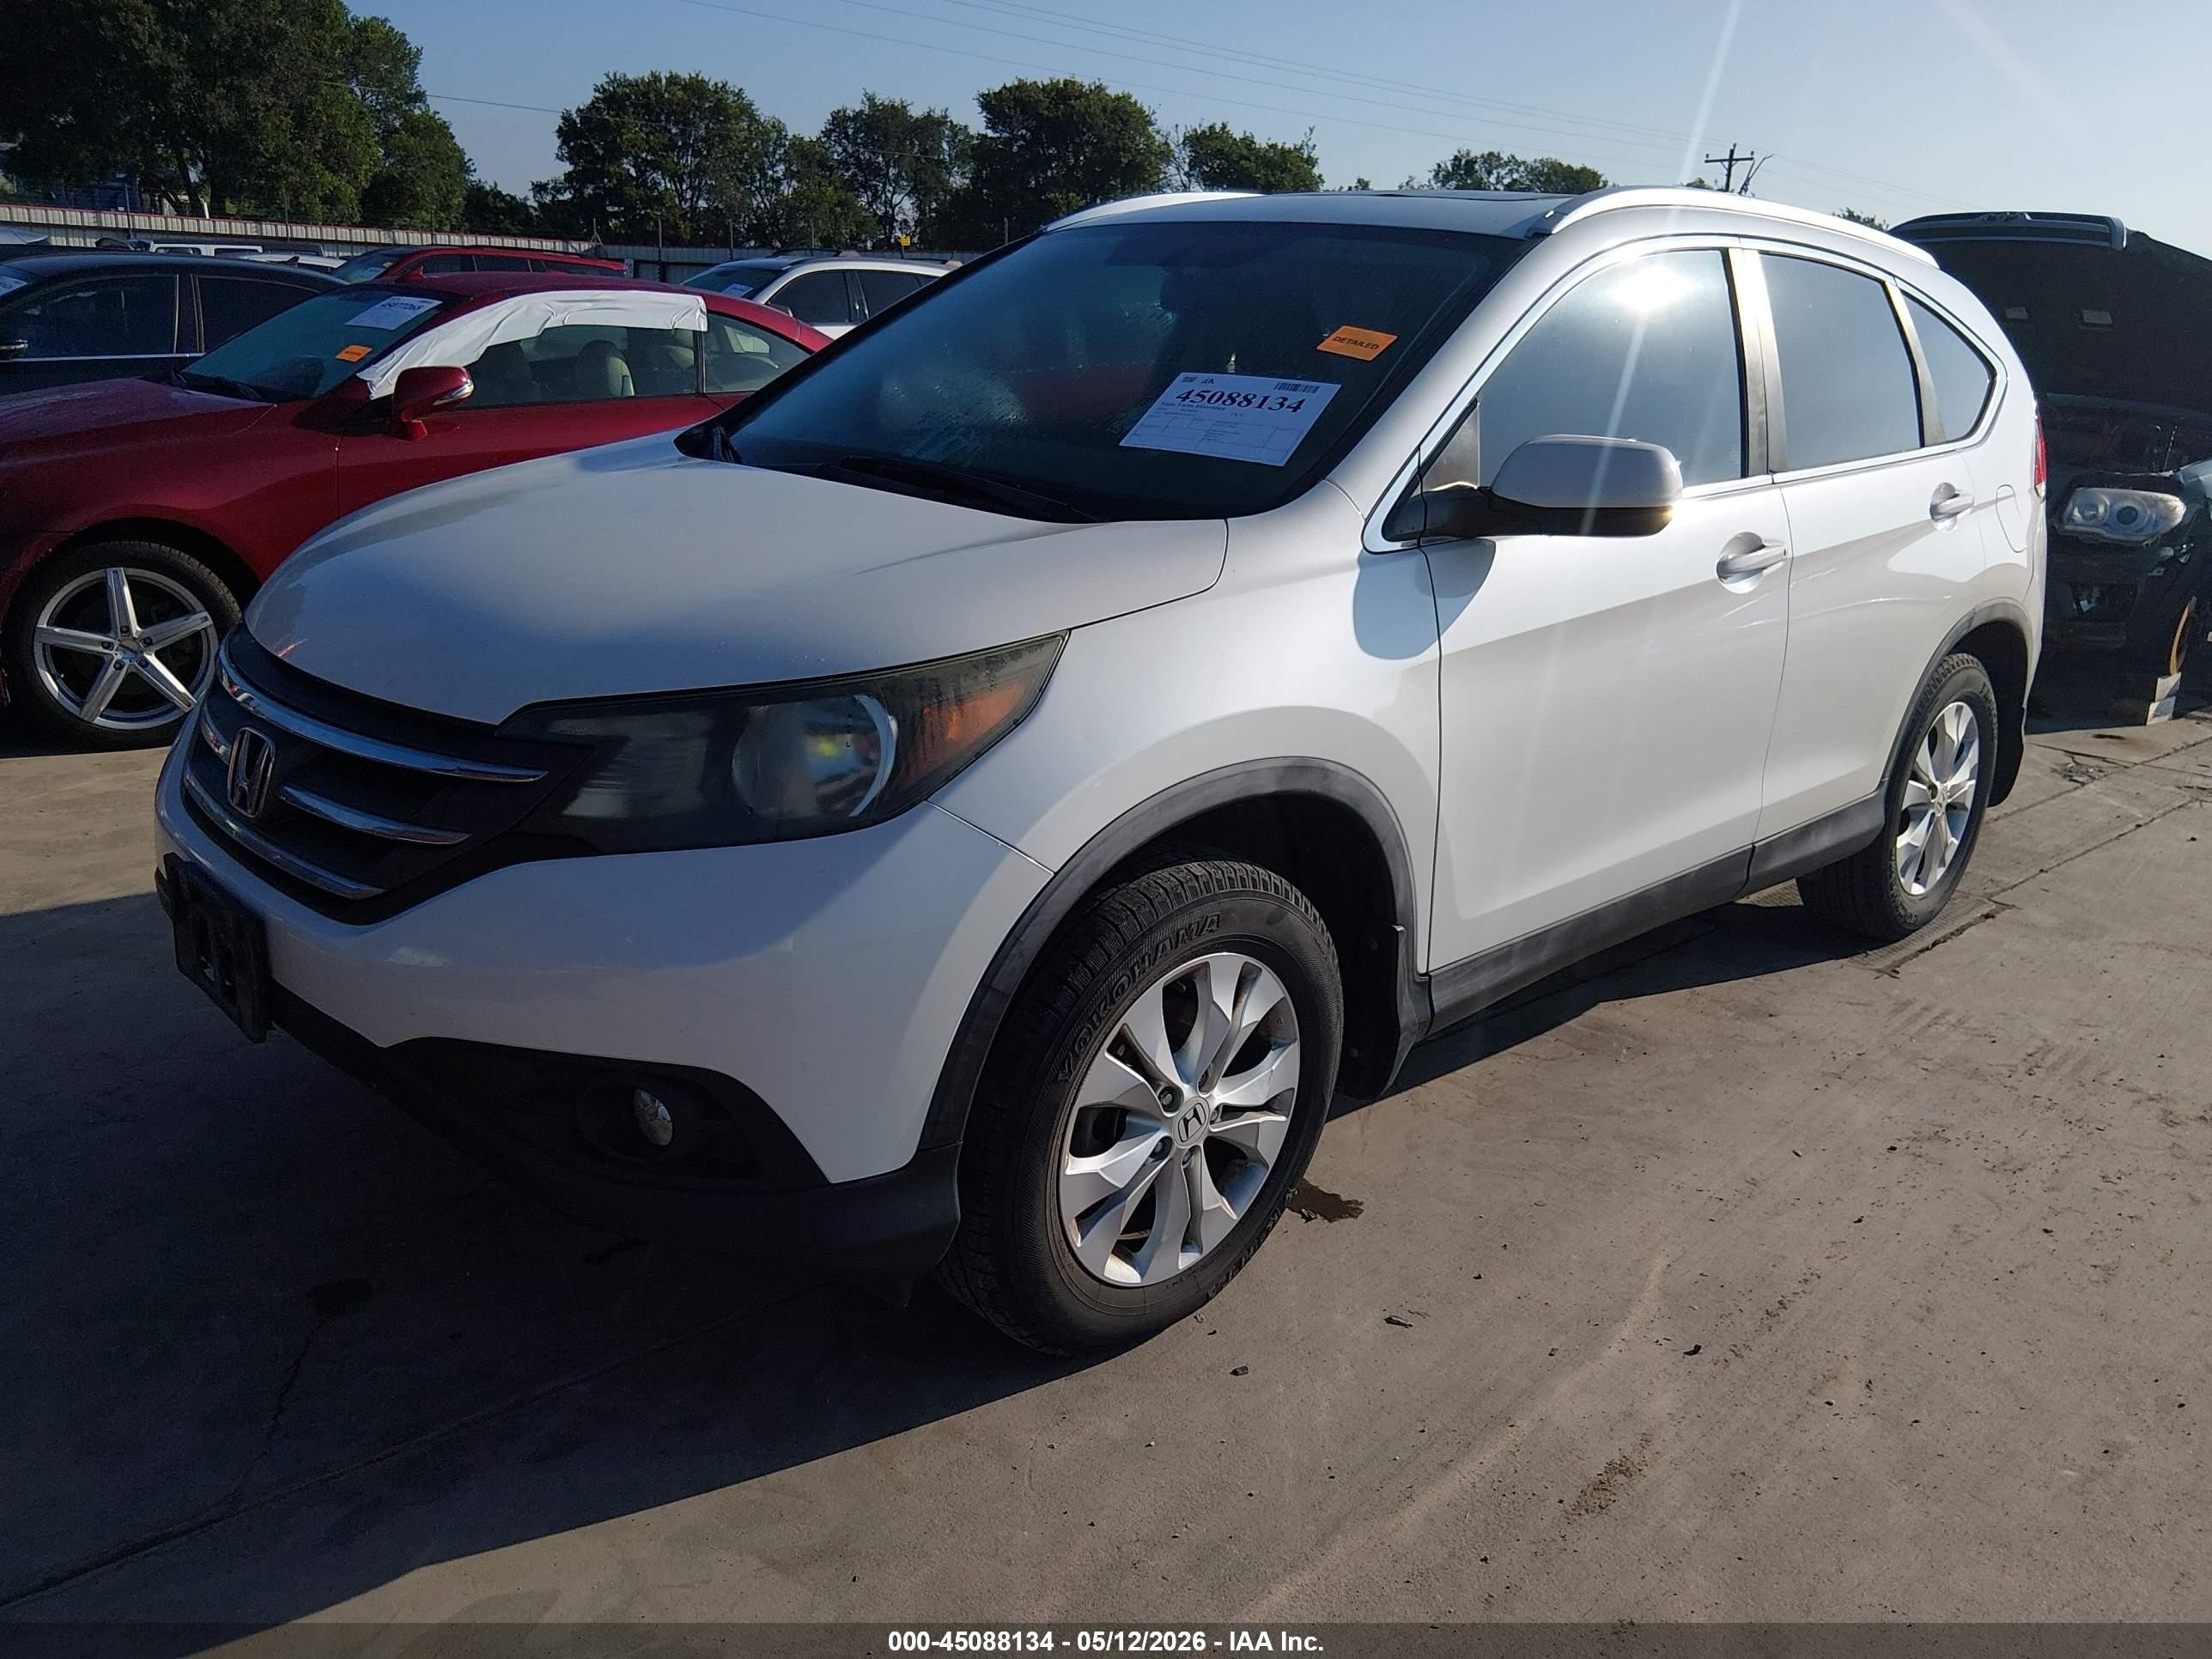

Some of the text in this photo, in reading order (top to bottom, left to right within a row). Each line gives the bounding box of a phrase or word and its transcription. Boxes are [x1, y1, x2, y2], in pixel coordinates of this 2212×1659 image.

[1333, 336, 1379, 350] DETAILED
[1175, 388, 1306, 413] 45088134
[1058, 912, 1220, 1082] YOKOHAMA
